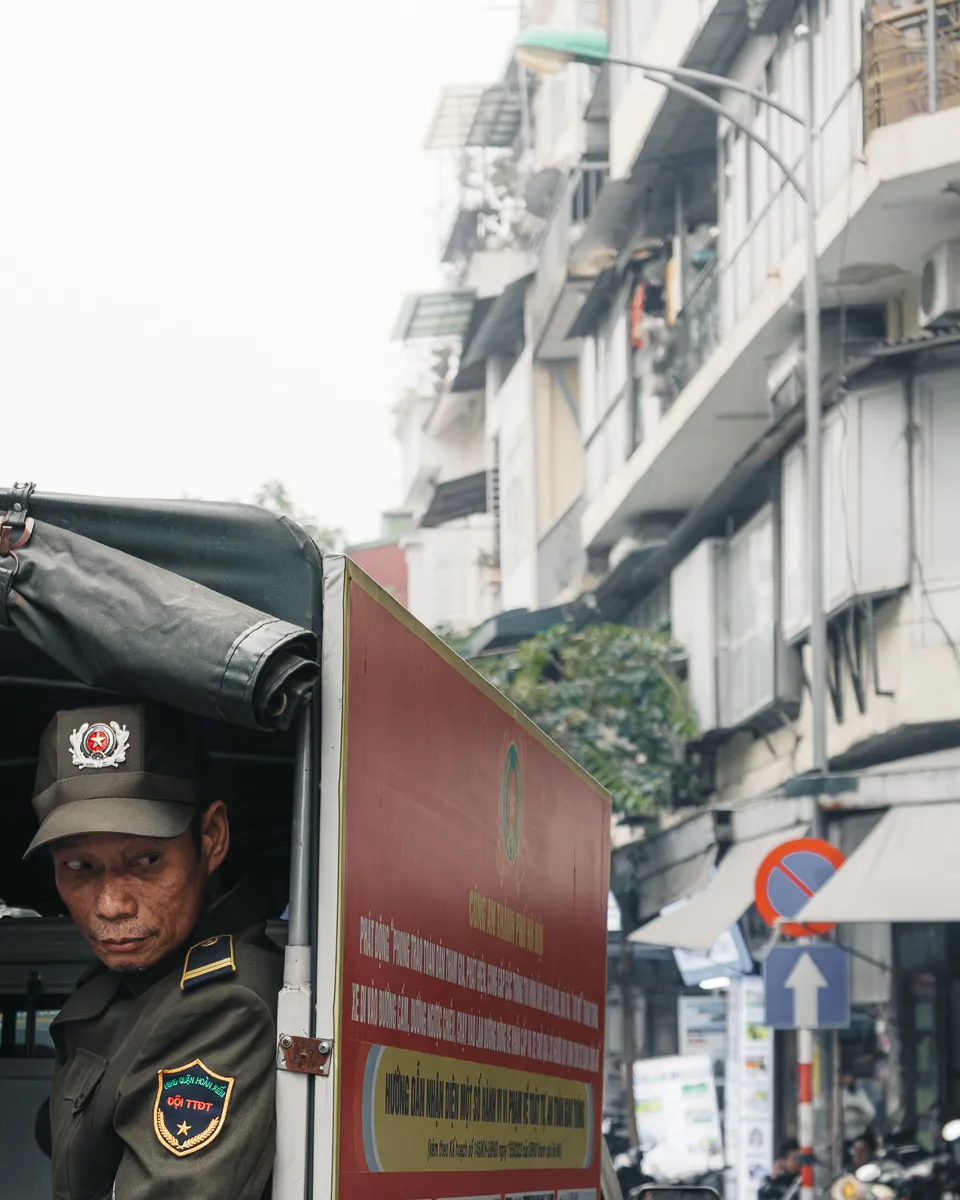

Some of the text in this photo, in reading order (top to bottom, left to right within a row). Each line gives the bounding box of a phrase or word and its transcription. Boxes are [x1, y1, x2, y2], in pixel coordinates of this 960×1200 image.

[359, 910, 374, 955] PHÁT
[374, 914, 389, 969] ĐỘNG
[351, 983, 359, 1021] XE
[367, 979, 377, 1027] VÀO
[378, 983, 396, 1030] ĐƯỜNG
[166, 1094, 213, 1112] ĐỘI TTĐT
[384, 1066, 409, 1117] HƯỚNG
[410, 1061, 424, 1117] DẪN
[425, 1068, 443, 1127] NHẬN
[444, 1072, 459, 1128] DIỆN
[459, 1075, 471, 1128] MỘT
[472, 1073, 481, 1122] SỐ
